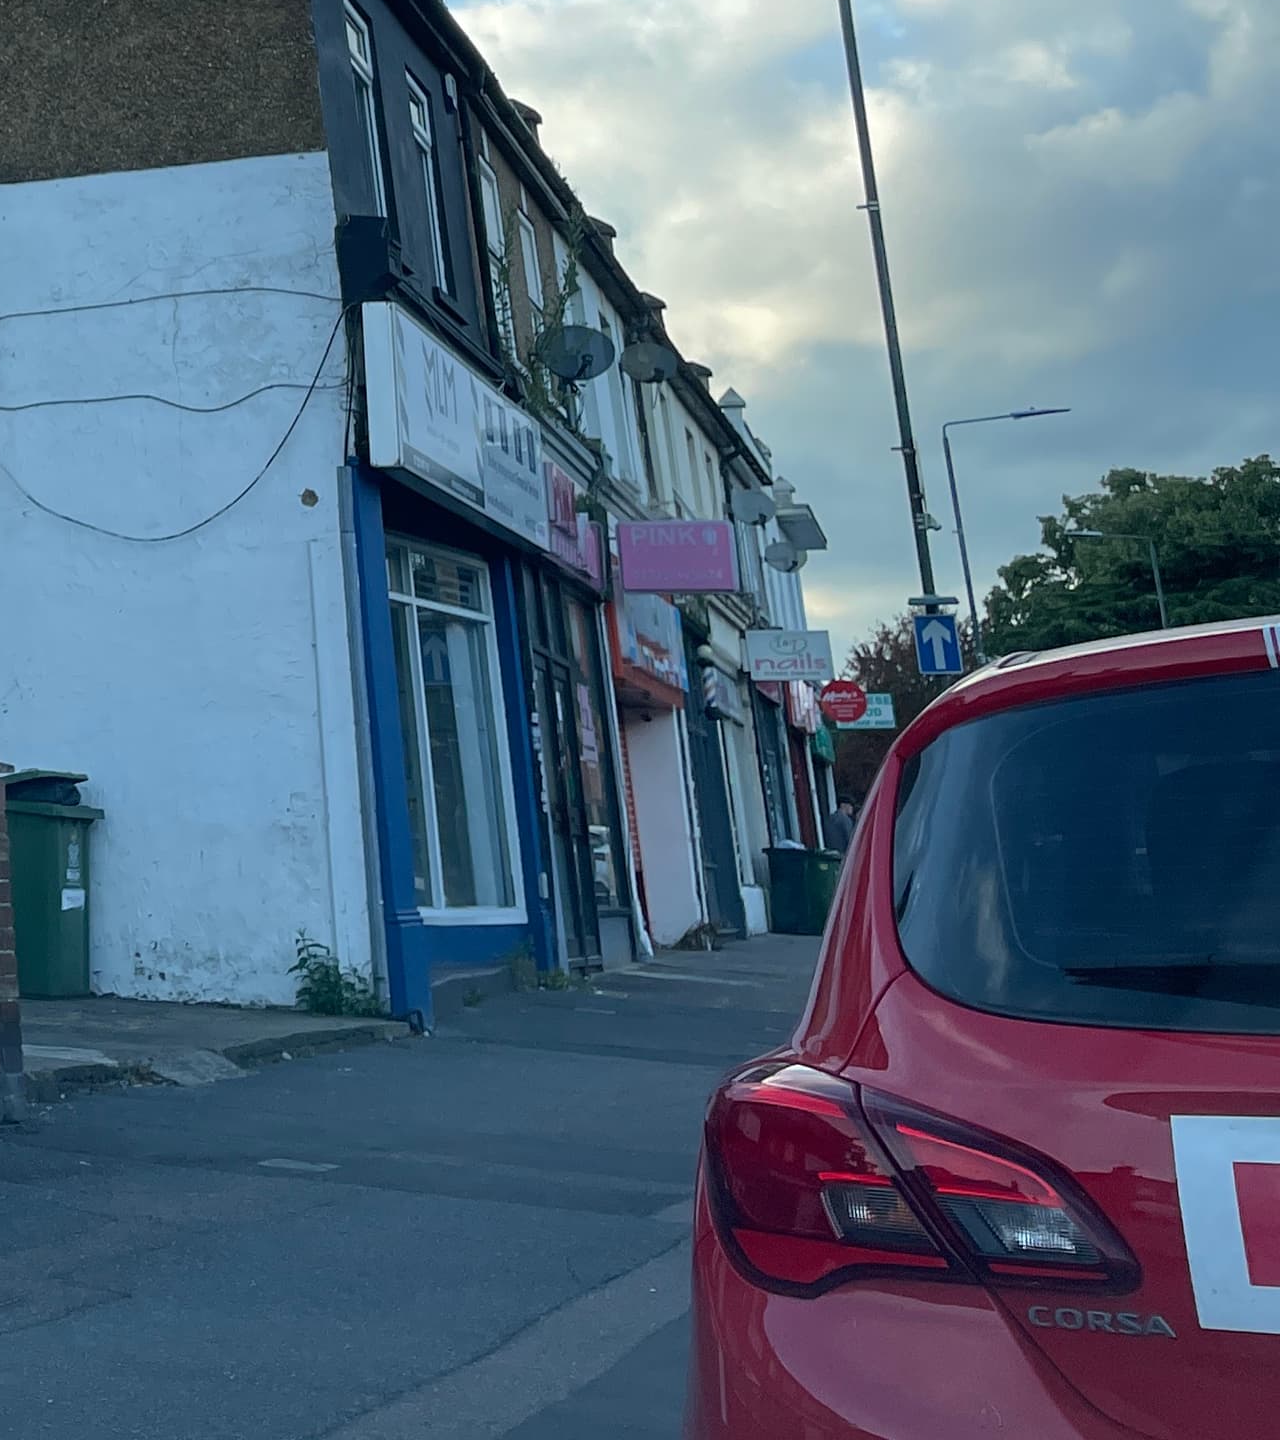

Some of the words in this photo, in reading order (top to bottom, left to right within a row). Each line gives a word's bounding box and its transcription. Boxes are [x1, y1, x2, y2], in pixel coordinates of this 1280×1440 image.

[629, 526, 697, 546] PINK
[754, 651, 827, 672] nails
[1028, 1306, 1177, 1341] CORSA
